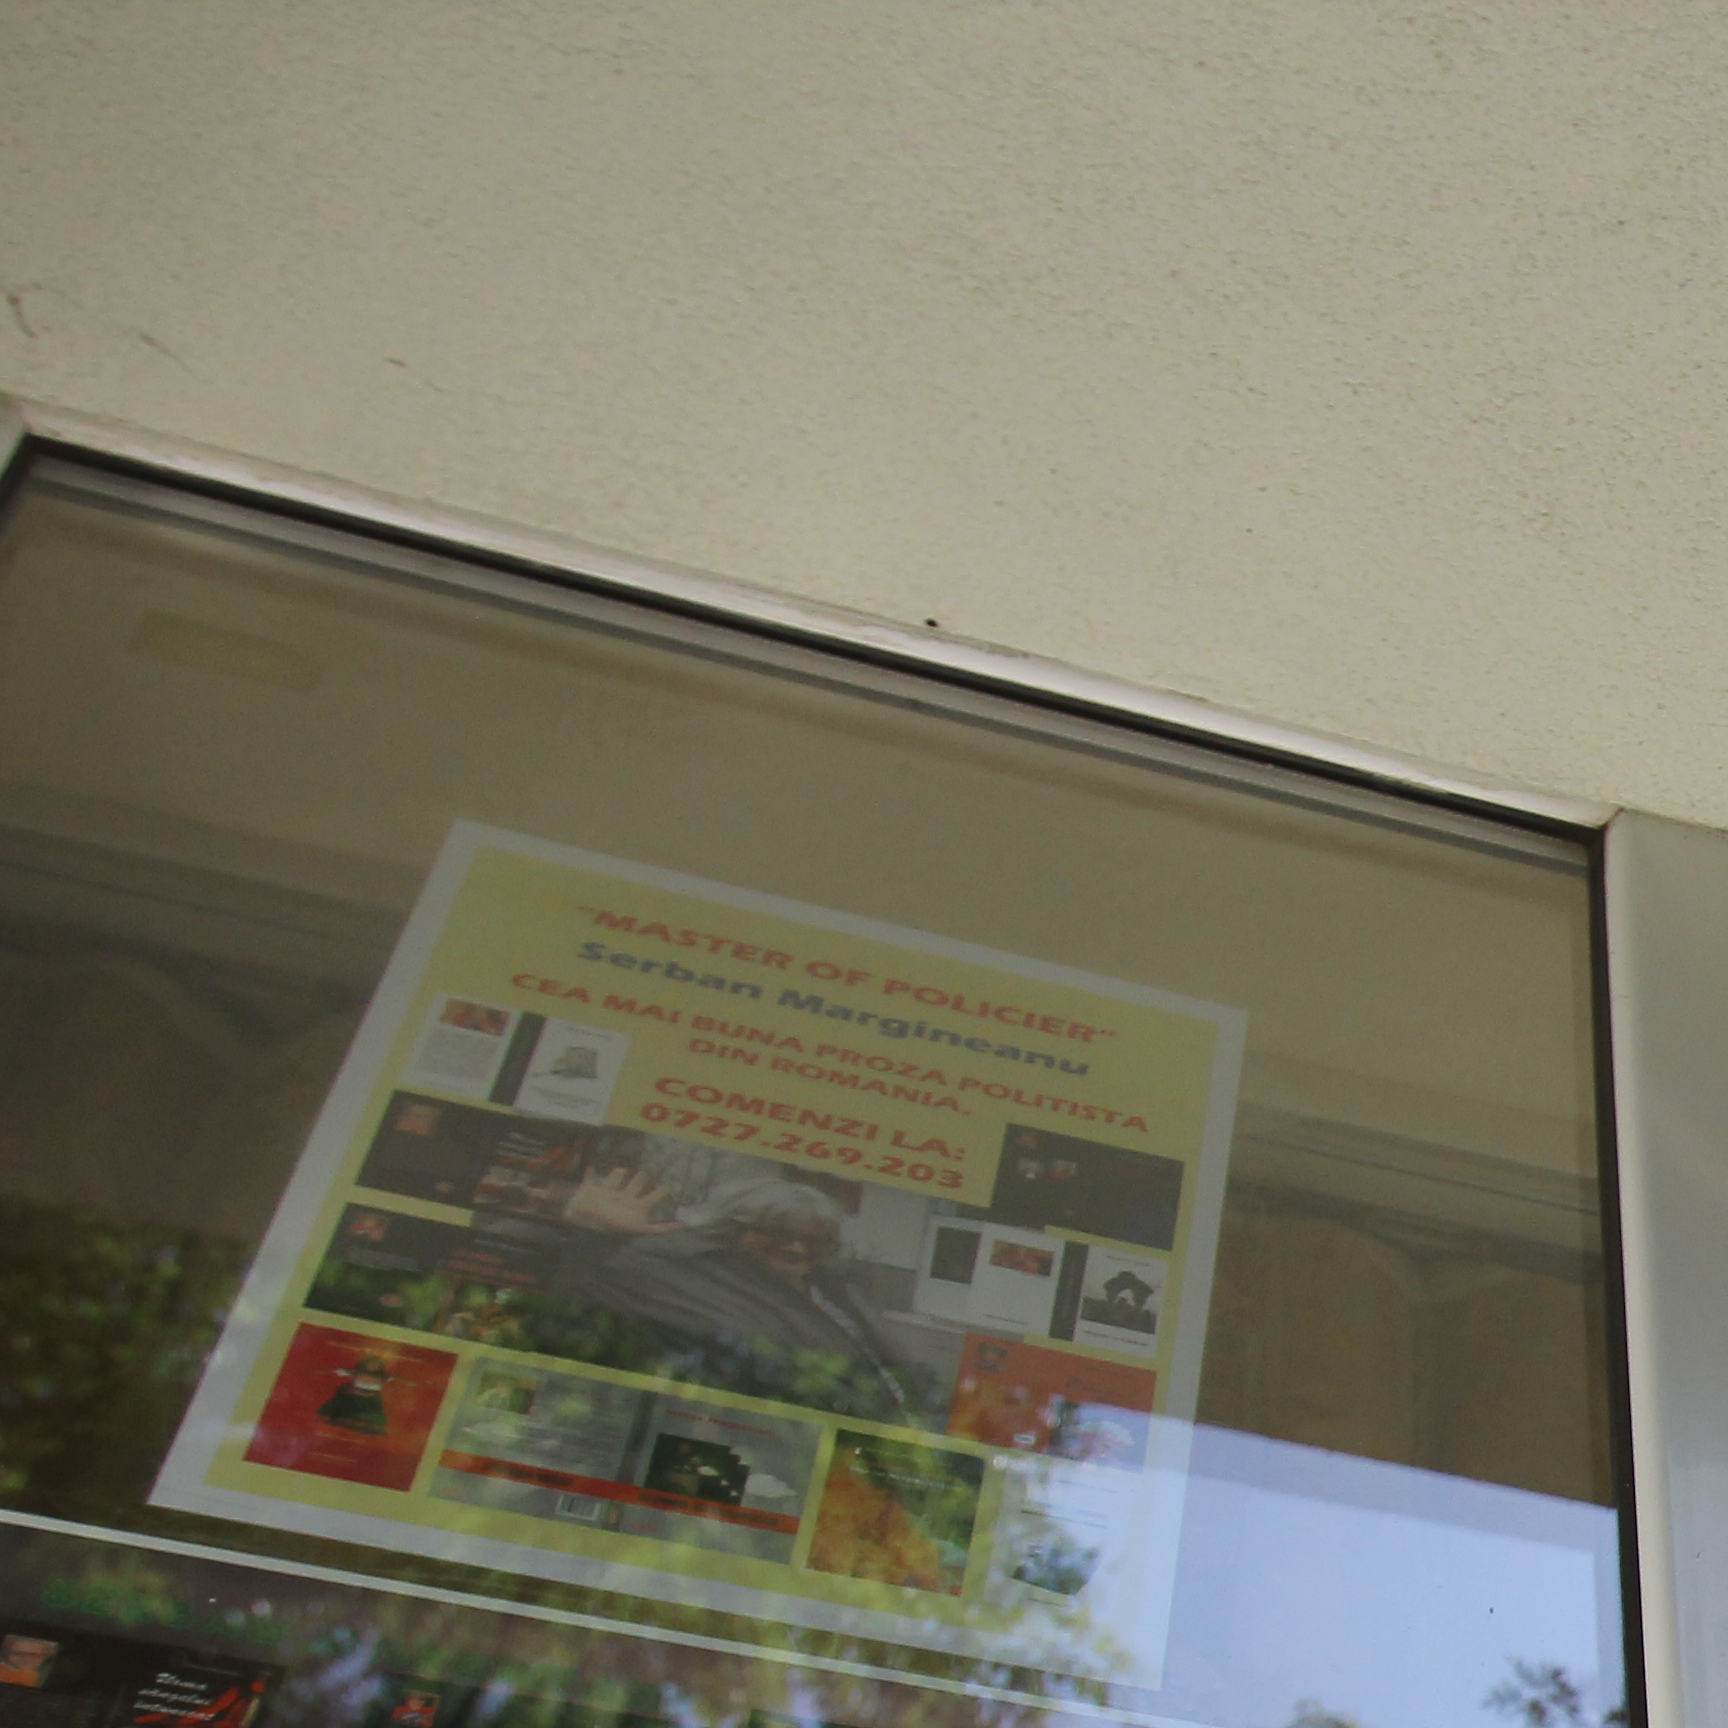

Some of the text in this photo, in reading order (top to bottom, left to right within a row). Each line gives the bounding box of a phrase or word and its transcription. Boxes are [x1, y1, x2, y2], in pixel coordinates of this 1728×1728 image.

[577, 941, 1090, 1078] Serban Margineanu
[805, 959, 873, 988] OF
[511, 973, 1149, 1133] CEA MAI BUNA PROZA POLITISTA
[688, 1036, 759, 1068] DIN
[640, 1100, 965, 1191] 0727.269.203
[654, 1076, 967, 1162] COMENZI LA:
